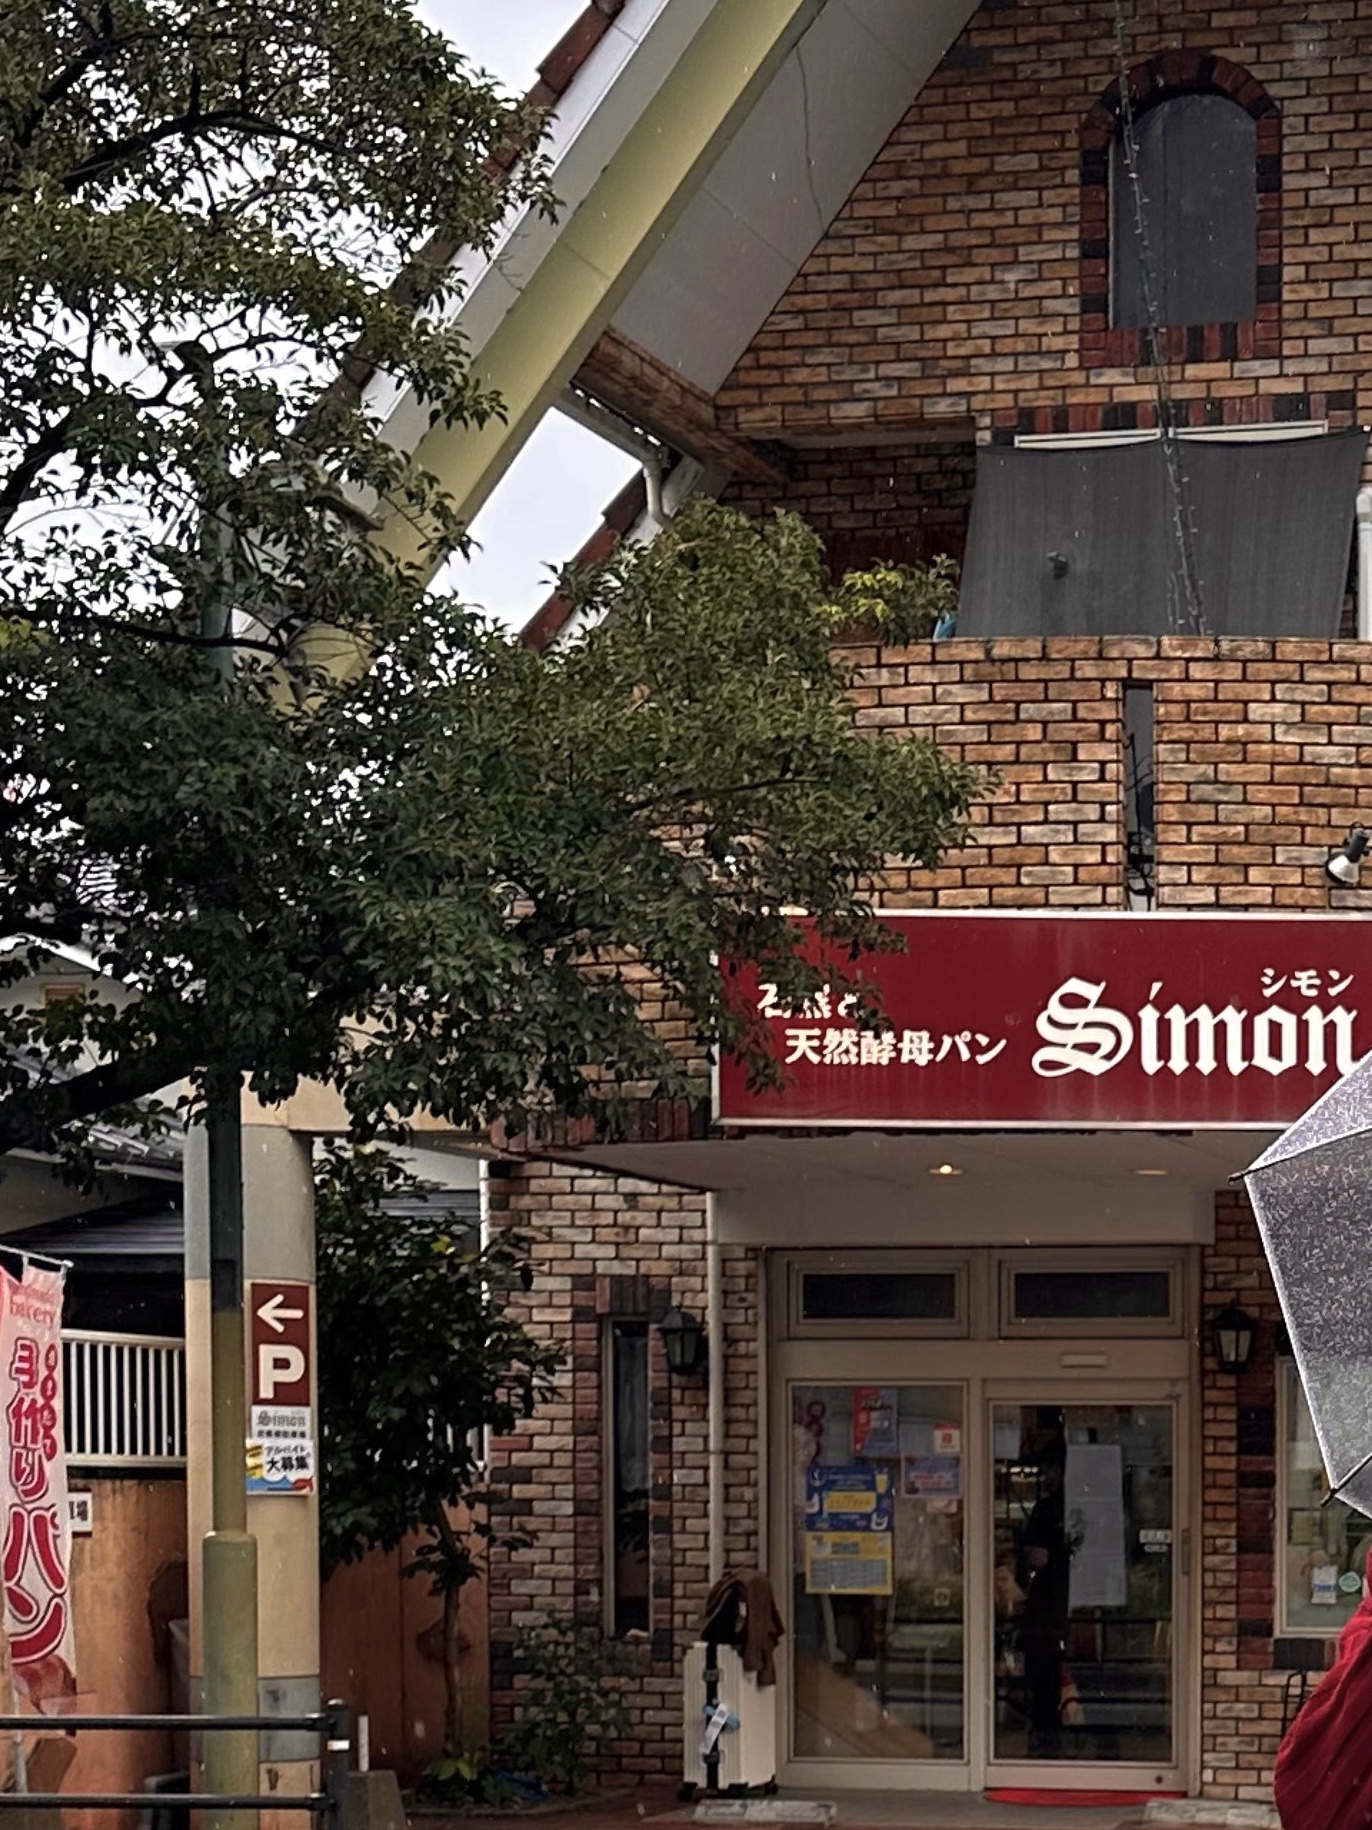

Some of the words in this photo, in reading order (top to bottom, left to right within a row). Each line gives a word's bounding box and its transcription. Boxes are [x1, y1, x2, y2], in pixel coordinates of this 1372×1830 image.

[1261, 968, 1354, 998] シモン
[784, 1027, 1008, 1066] 天然酵母パン
[1031, 976, 1358, 1078] Simon
[258, 1344, 306, 1399] P
